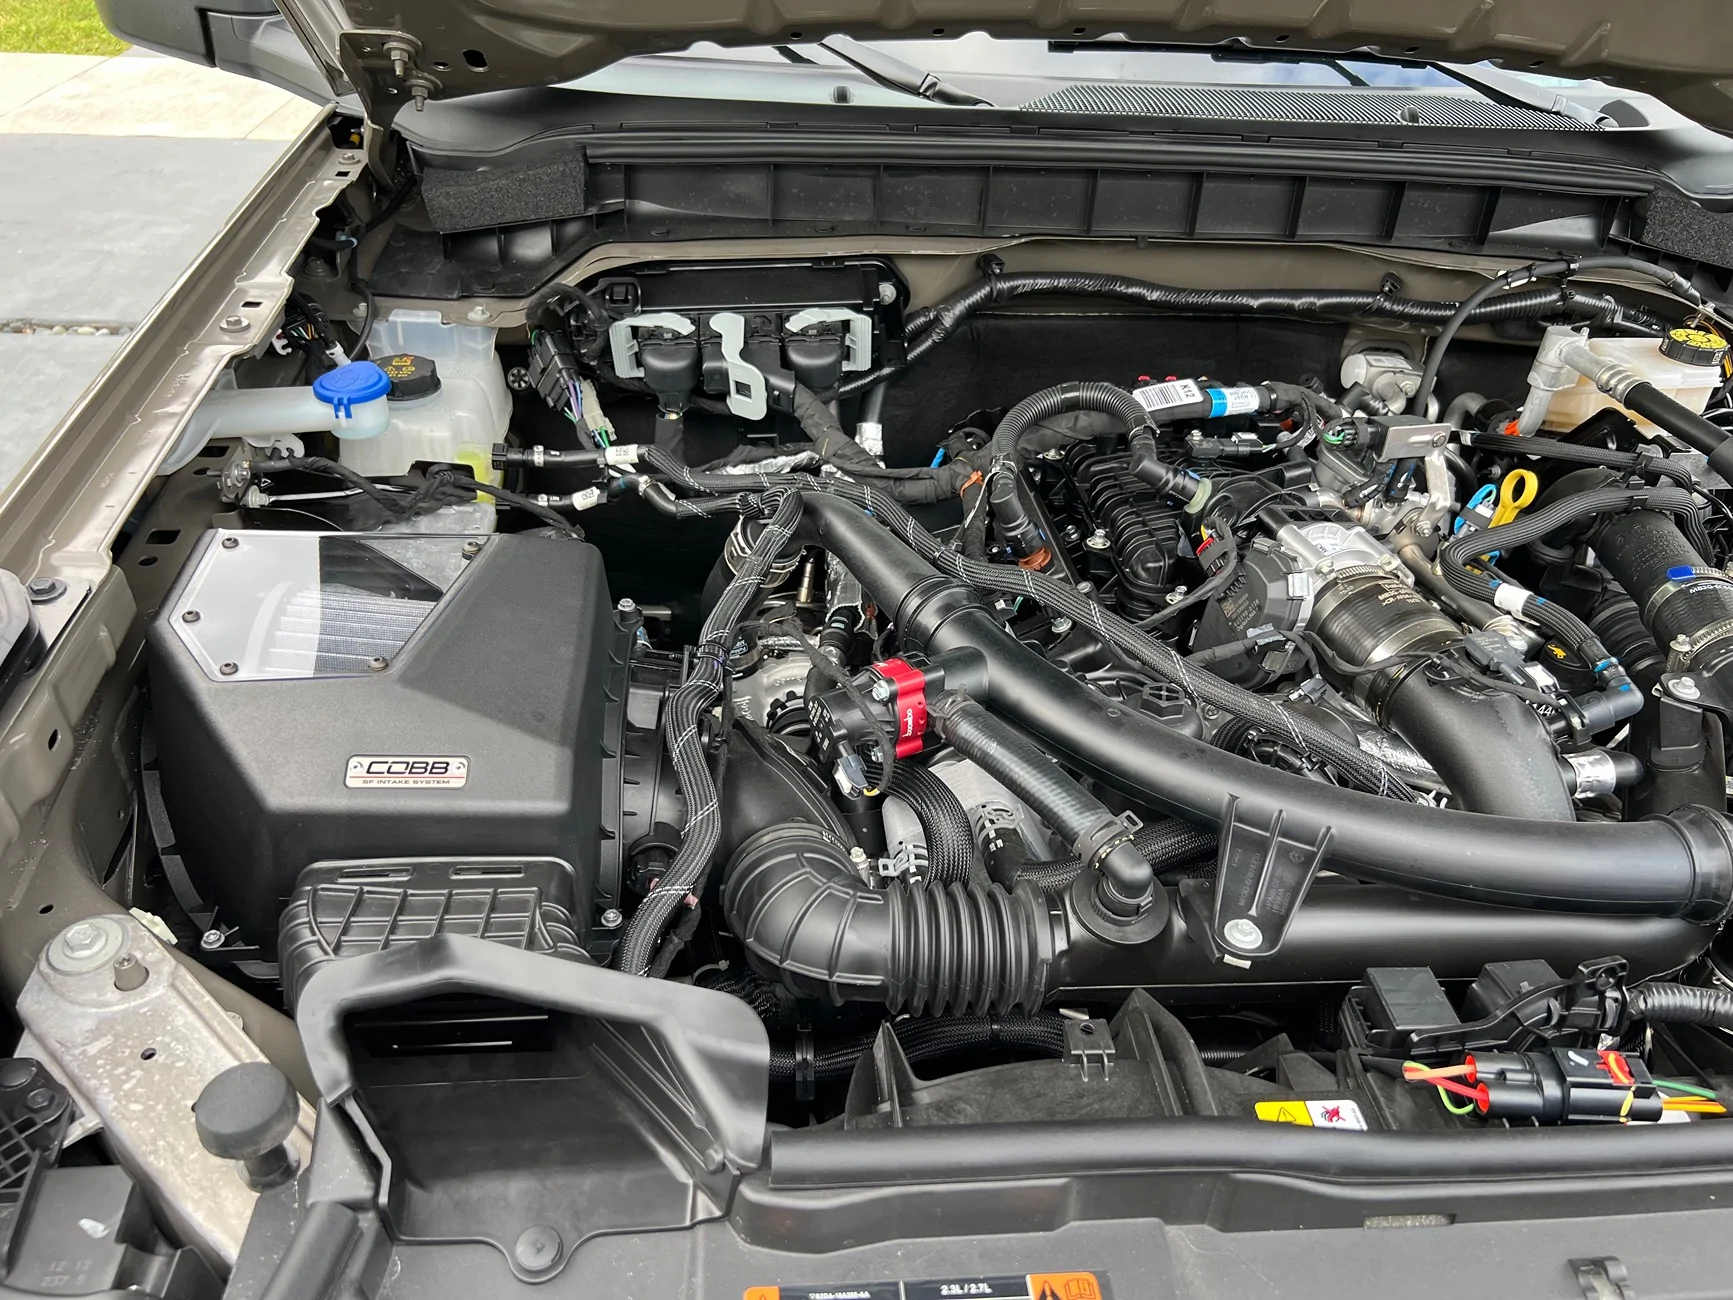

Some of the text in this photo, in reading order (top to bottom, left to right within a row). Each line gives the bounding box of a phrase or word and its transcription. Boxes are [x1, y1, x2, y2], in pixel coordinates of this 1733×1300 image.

[1181, 384, 1195, 398] K12
[366, 761, 450, 775] COBB
[940, 1284, 963, 1296] 2.3L
[970, 1282, 993, 1295] 2.7L
